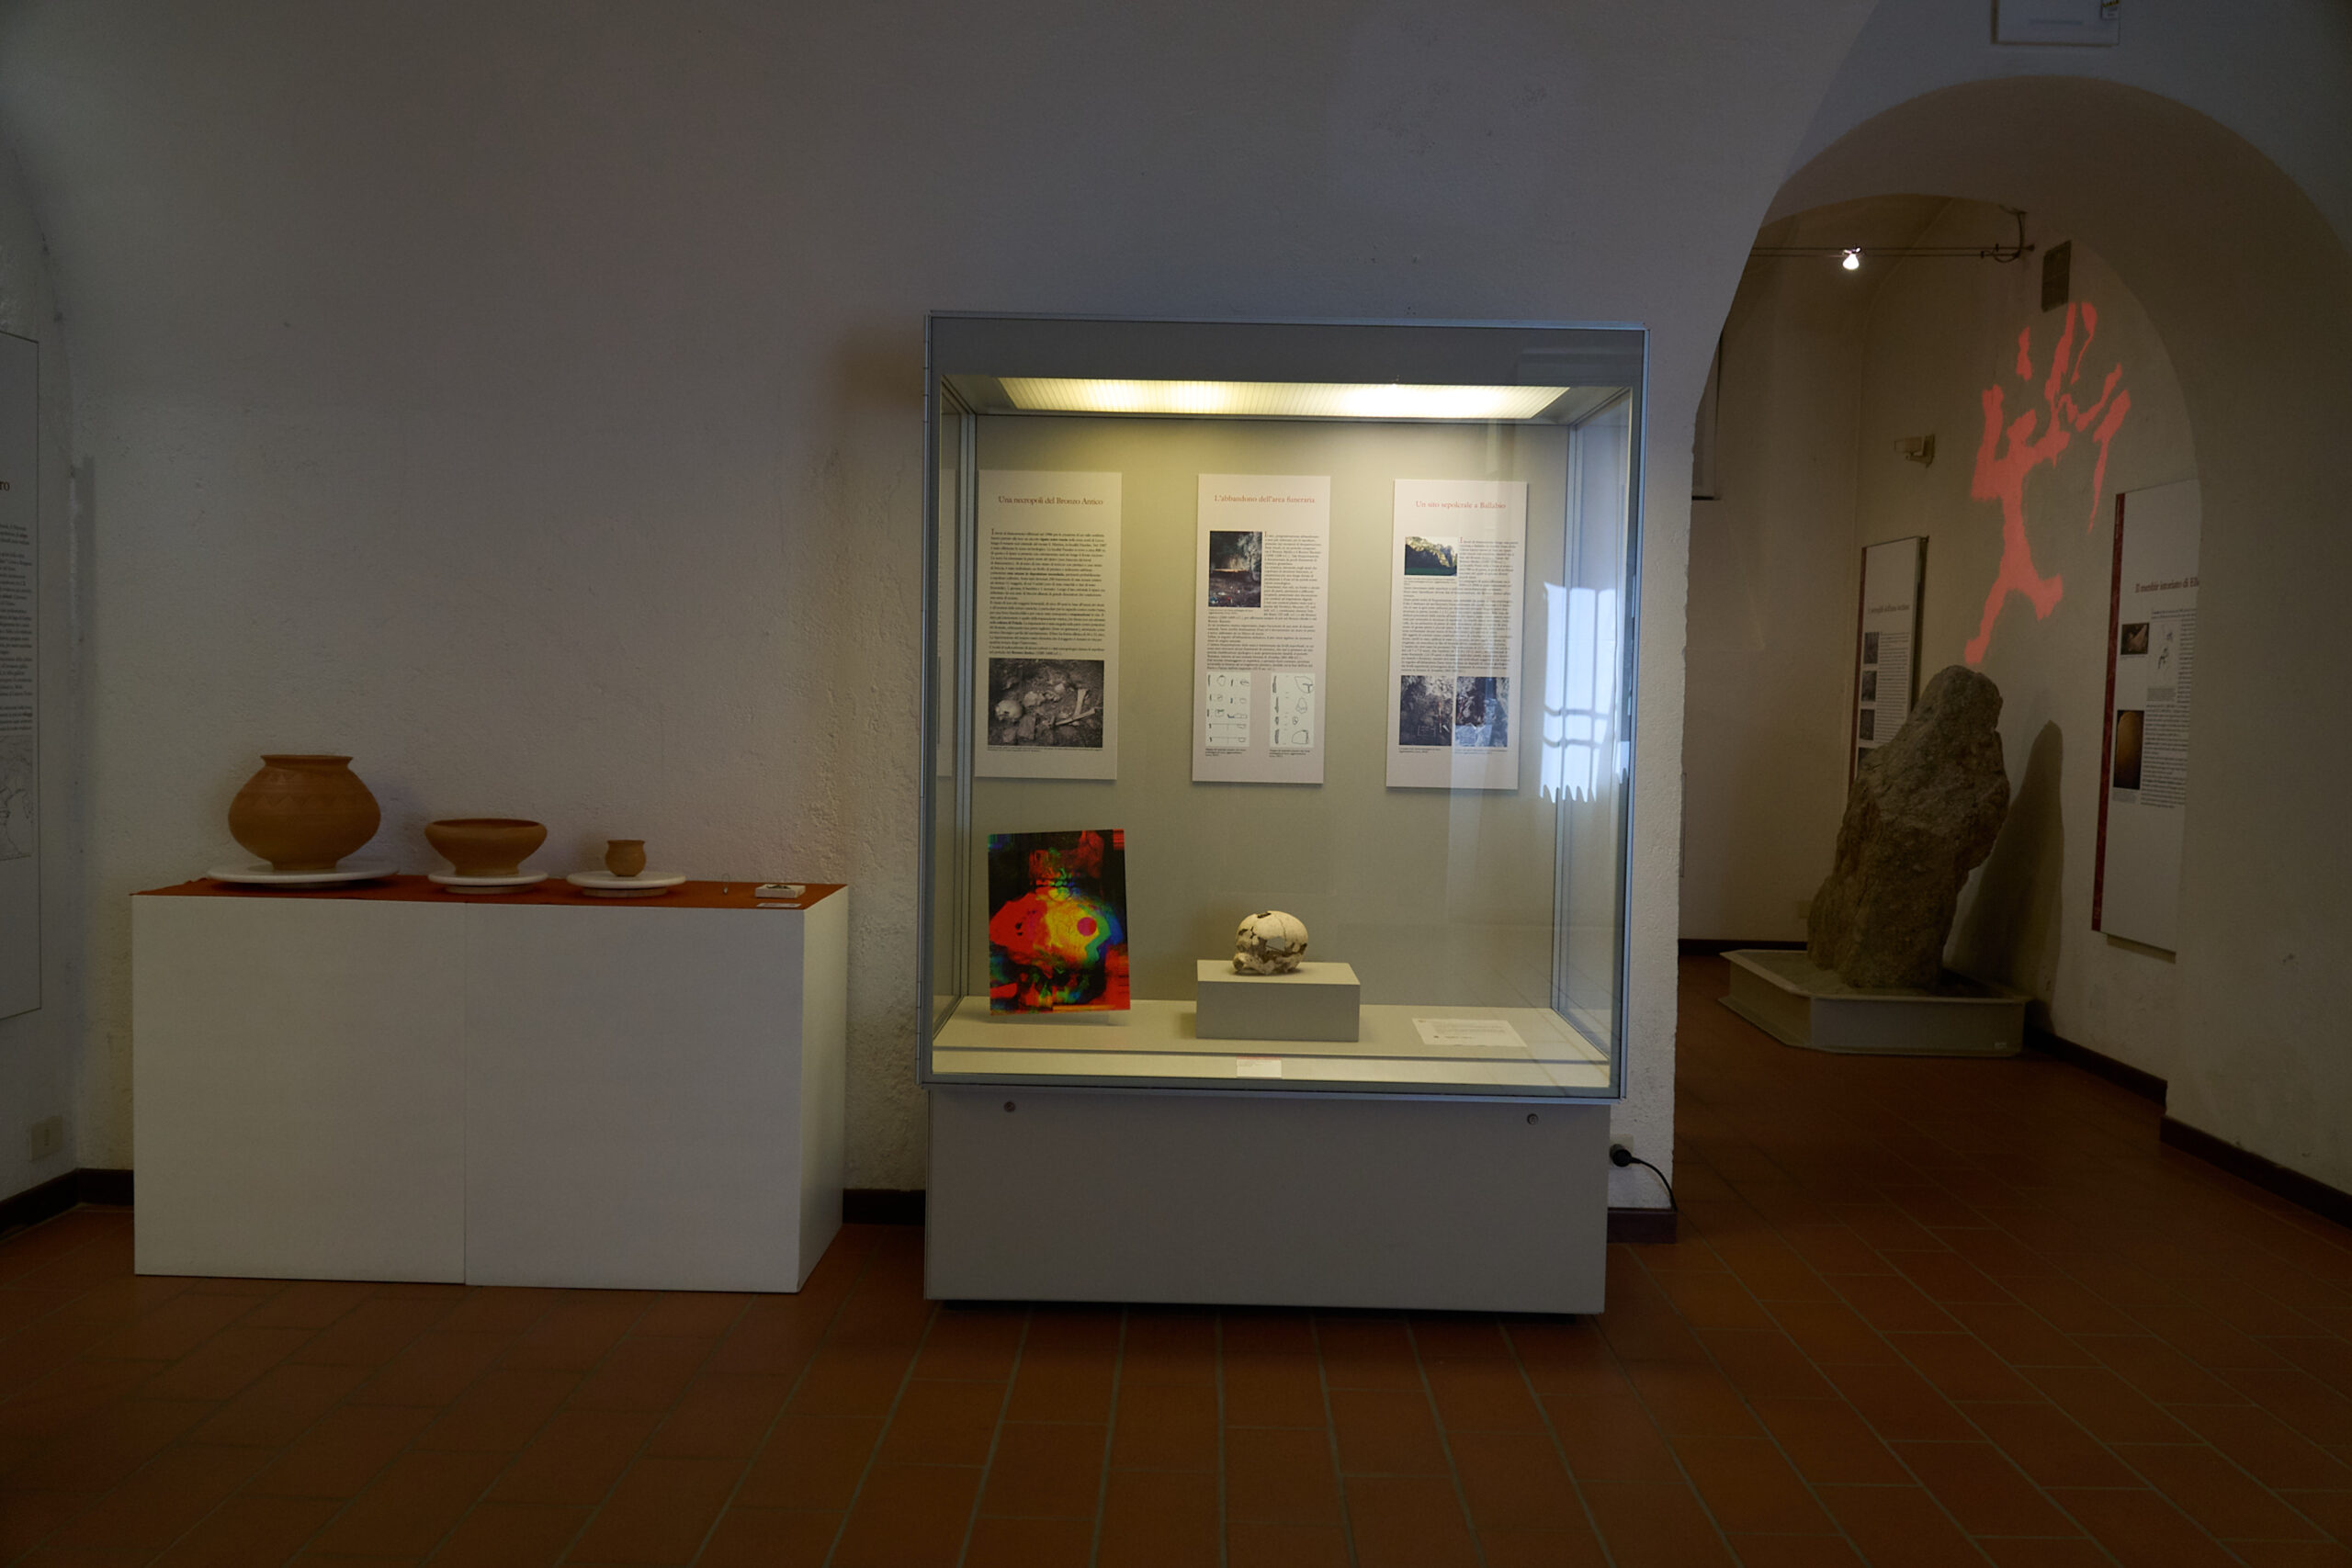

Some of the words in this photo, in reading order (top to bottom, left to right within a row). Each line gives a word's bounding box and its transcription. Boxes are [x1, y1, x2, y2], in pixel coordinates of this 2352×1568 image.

[998, 496, 1012, 504] Una
[1013, 497, 1044, 506] necropoli
[1045, 497, 1055, 505] del
[1056, 497, 1080, 505] Bronzo
[1081, 497, 1103, 505] Antico
[1259, 495, 1285, 503] dell'area
[1441, 501, 1473, 510] sepolcrale
